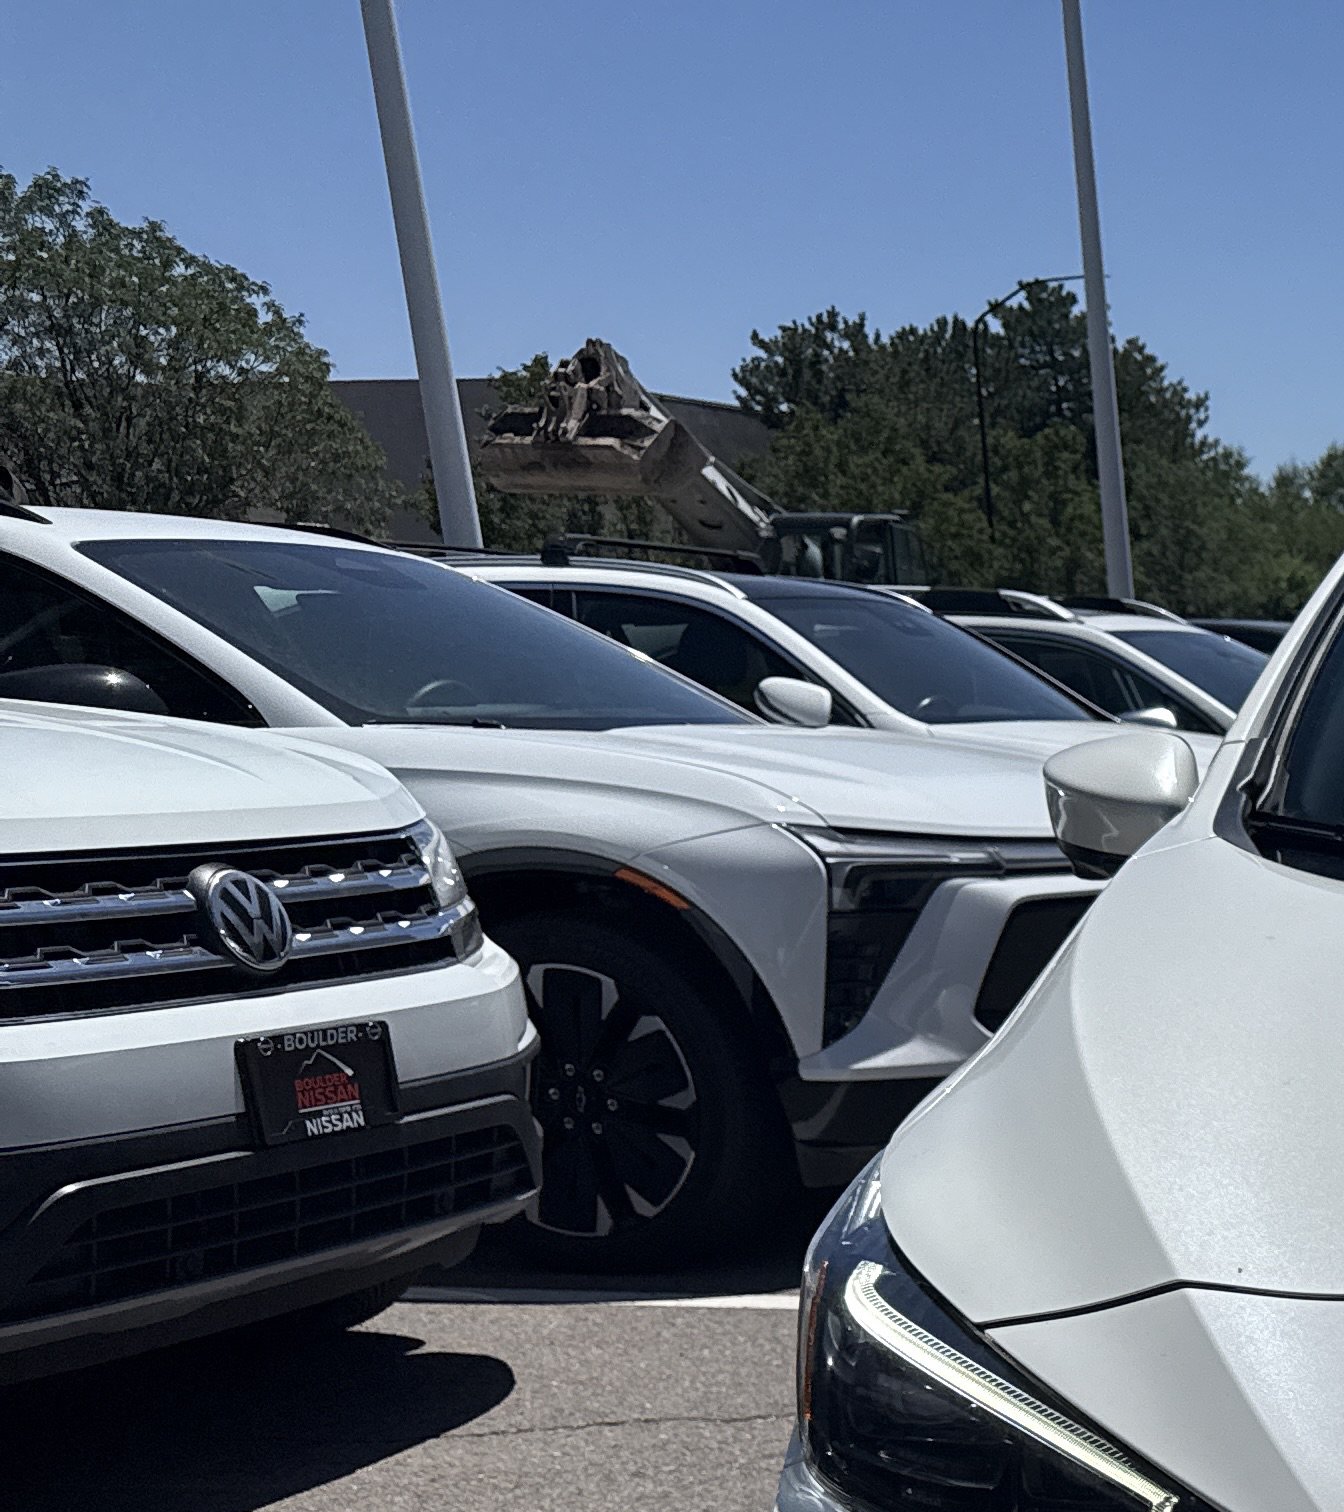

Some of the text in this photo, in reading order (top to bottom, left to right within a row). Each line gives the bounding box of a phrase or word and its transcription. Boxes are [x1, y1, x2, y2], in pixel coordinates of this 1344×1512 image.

[284, 1026, 357, 1052] BOULDER
[294, 1072, 349, 1091] BOULDER
[296, 1083, 360, 1108] NISSAN
[305, 1111, 365, 1136] NISSAN
